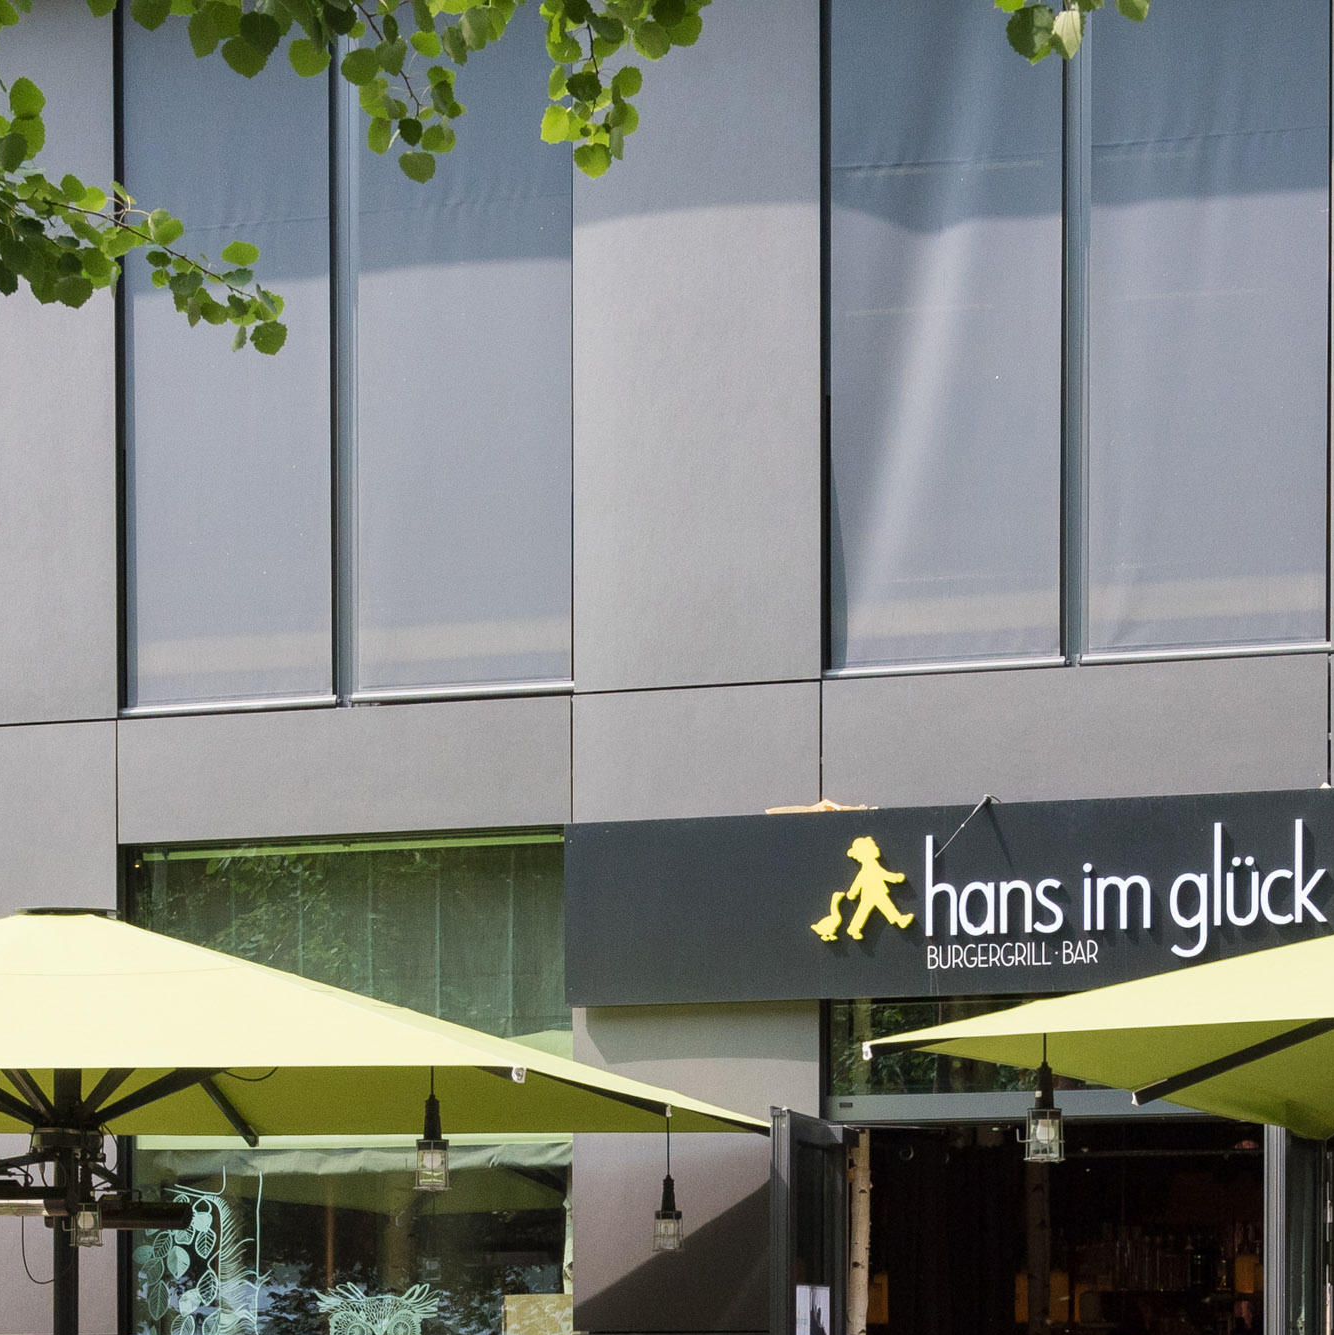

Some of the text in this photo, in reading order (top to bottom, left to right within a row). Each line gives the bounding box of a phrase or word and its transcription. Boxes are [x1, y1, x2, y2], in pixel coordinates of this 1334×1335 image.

[925, 818, 1328, 958] hans im glück
[927, 939, 1099, 970] BURGERGRILL BAR
